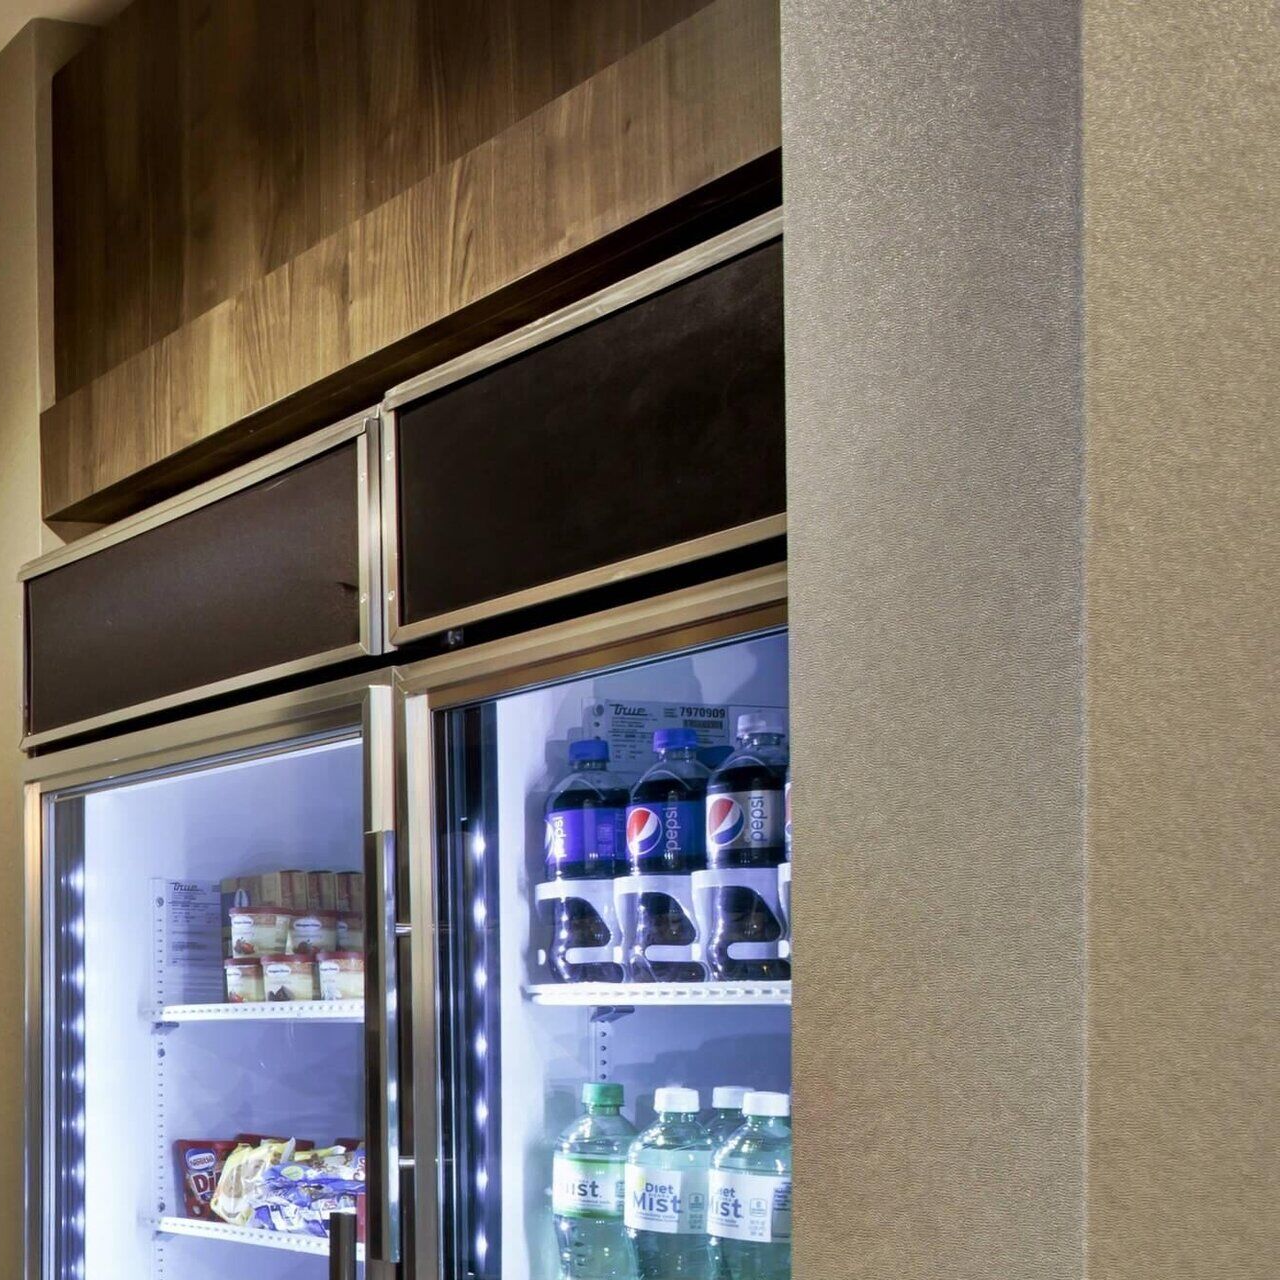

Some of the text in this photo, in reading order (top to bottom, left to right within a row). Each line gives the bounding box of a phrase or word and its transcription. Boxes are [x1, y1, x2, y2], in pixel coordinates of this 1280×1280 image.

[679, 706, 726, 719] 7970909
[553, 815, 567, 859] ppsi
[663, 806, 681, 851] pepsi
[751, 795, 768, 842] pepsi
[645, 1182, 674, 1195] Diet
